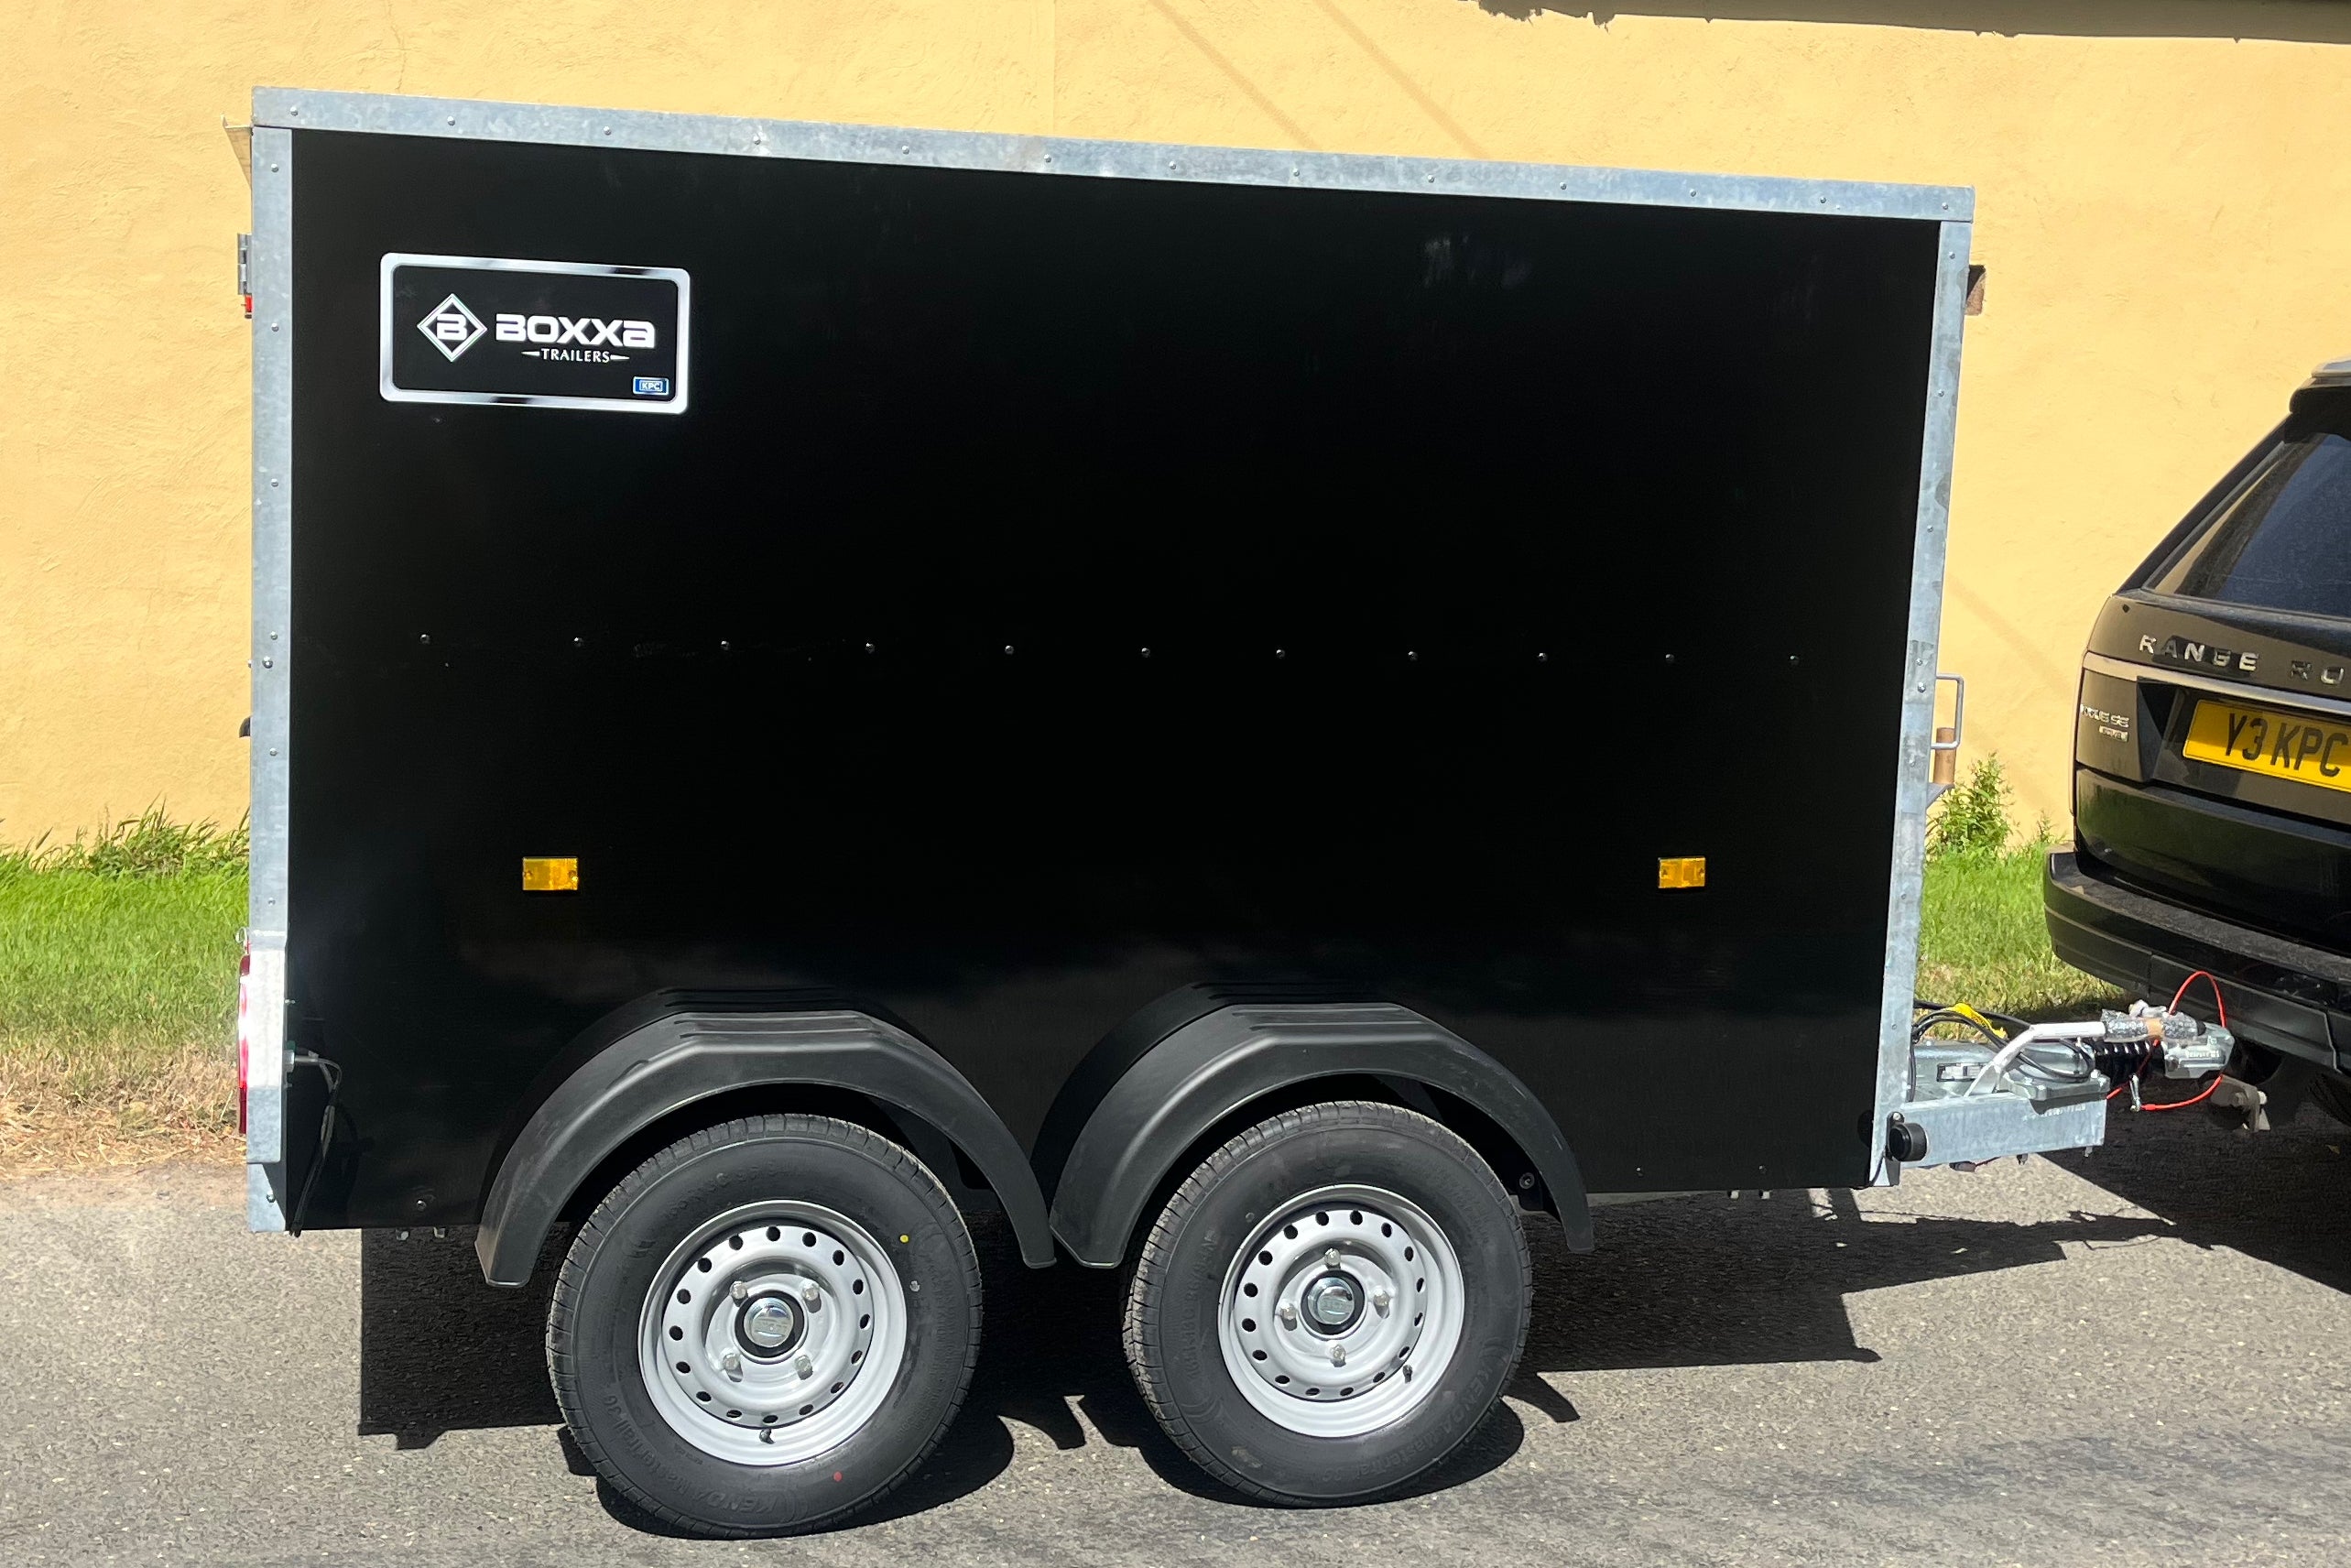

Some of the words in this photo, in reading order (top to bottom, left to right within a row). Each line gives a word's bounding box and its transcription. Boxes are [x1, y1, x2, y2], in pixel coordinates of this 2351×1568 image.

[541, 348, 610, 363] TRAILERS
[641, 381, 660, 391] KPC
[2139, 634, 2260, 671] RANGE
[2226, 713, 2269, 761] Y3
[2269, 722, 2349, 778] KPC
